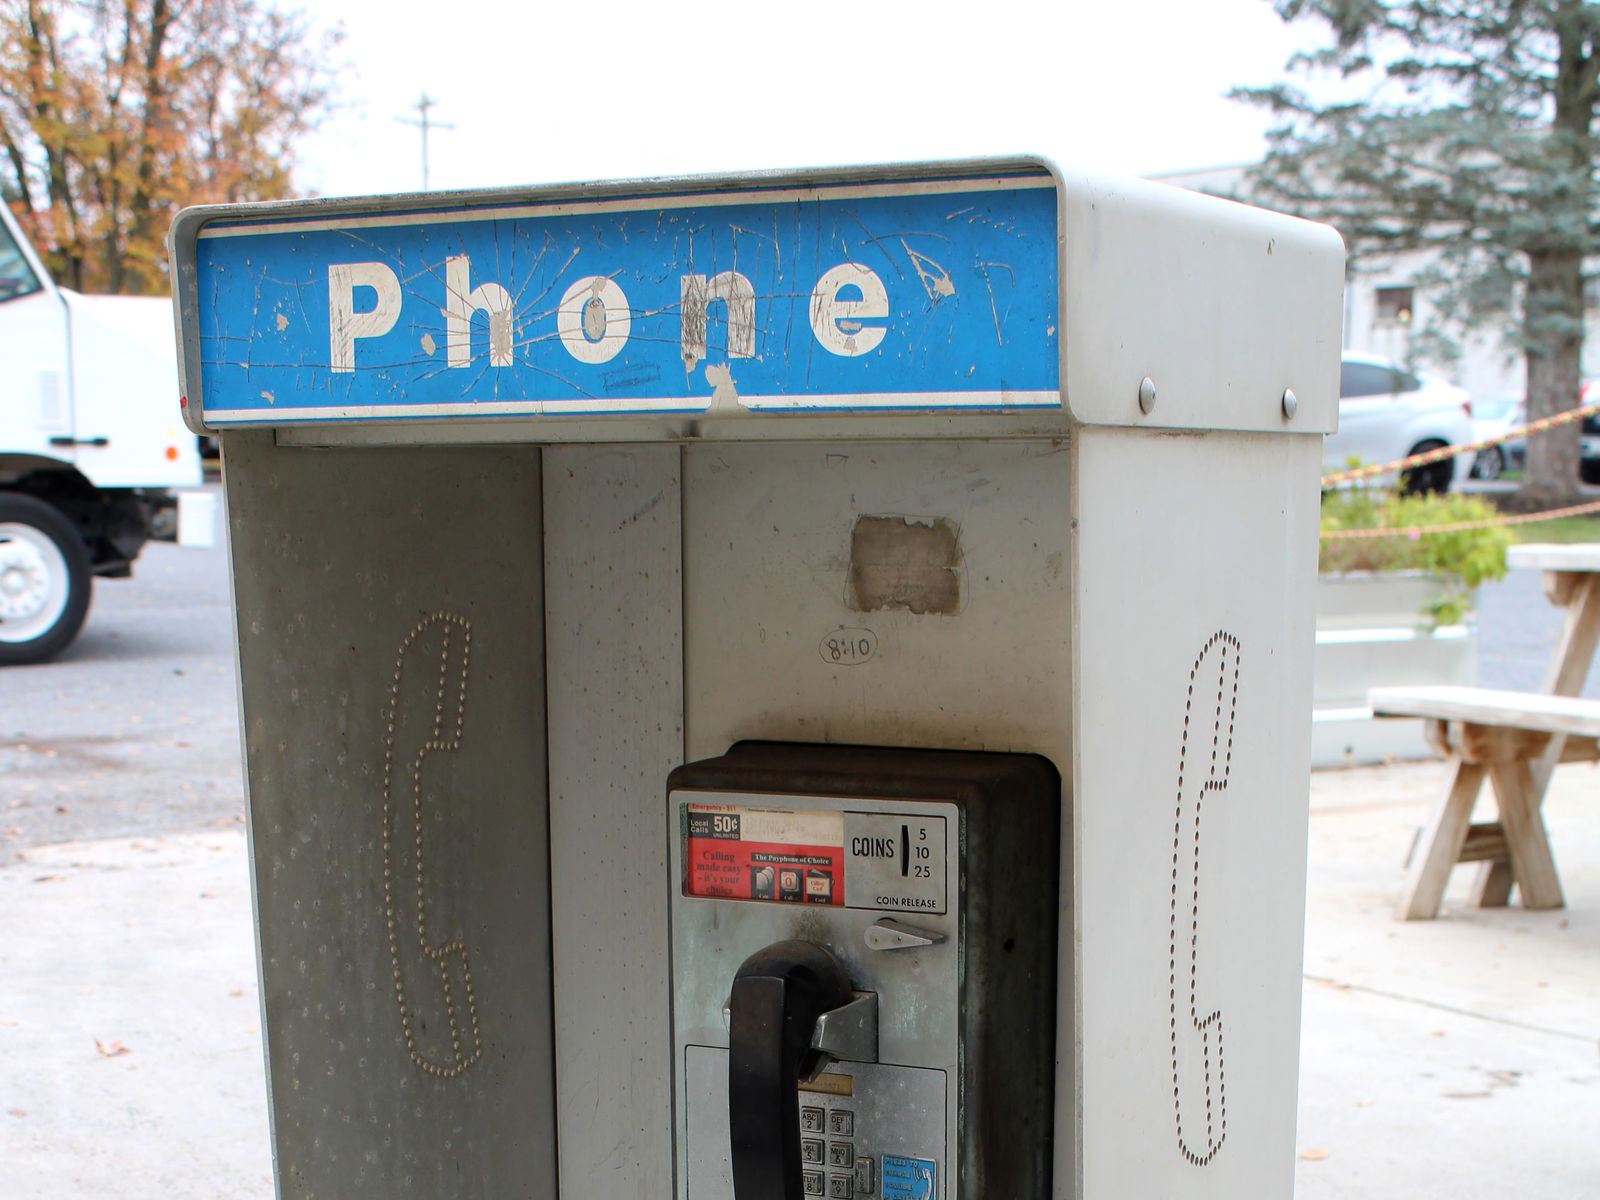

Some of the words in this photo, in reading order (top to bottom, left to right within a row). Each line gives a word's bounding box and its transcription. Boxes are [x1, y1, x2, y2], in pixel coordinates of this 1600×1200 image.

[328, 254, 889, 374] Phone
[690, 819, 709, 828] Local
[713, 815, 738, 833] 50¢
[690, 826, 709, 834] Calls
[919, 828, 926, 840] 5
[852, 837, 894, 858] COINS
[703, 850, 735, 862] Calling
[915, 846, 929, 859] 10
[807, 857, 830, 865] Choice
[697, 863, 717, 873] made
[722, 864, 741, 874] easy
[914, 865, 931, 878] 25
[876, 896, 898, 905] COIN
[901, 897, 936, 908] RELEASE
[802, 1113, 816, 1121] ABC
[831, 1115, 844, 1124] DEF
[806, 1121, 812, 1129] 2
[835, 1123, 841, 1132] 3
[806, 1152, 812, 1160] 5
[806, 1182, 812, 1191] 8
[835, 1185, 841, 1194] 9
